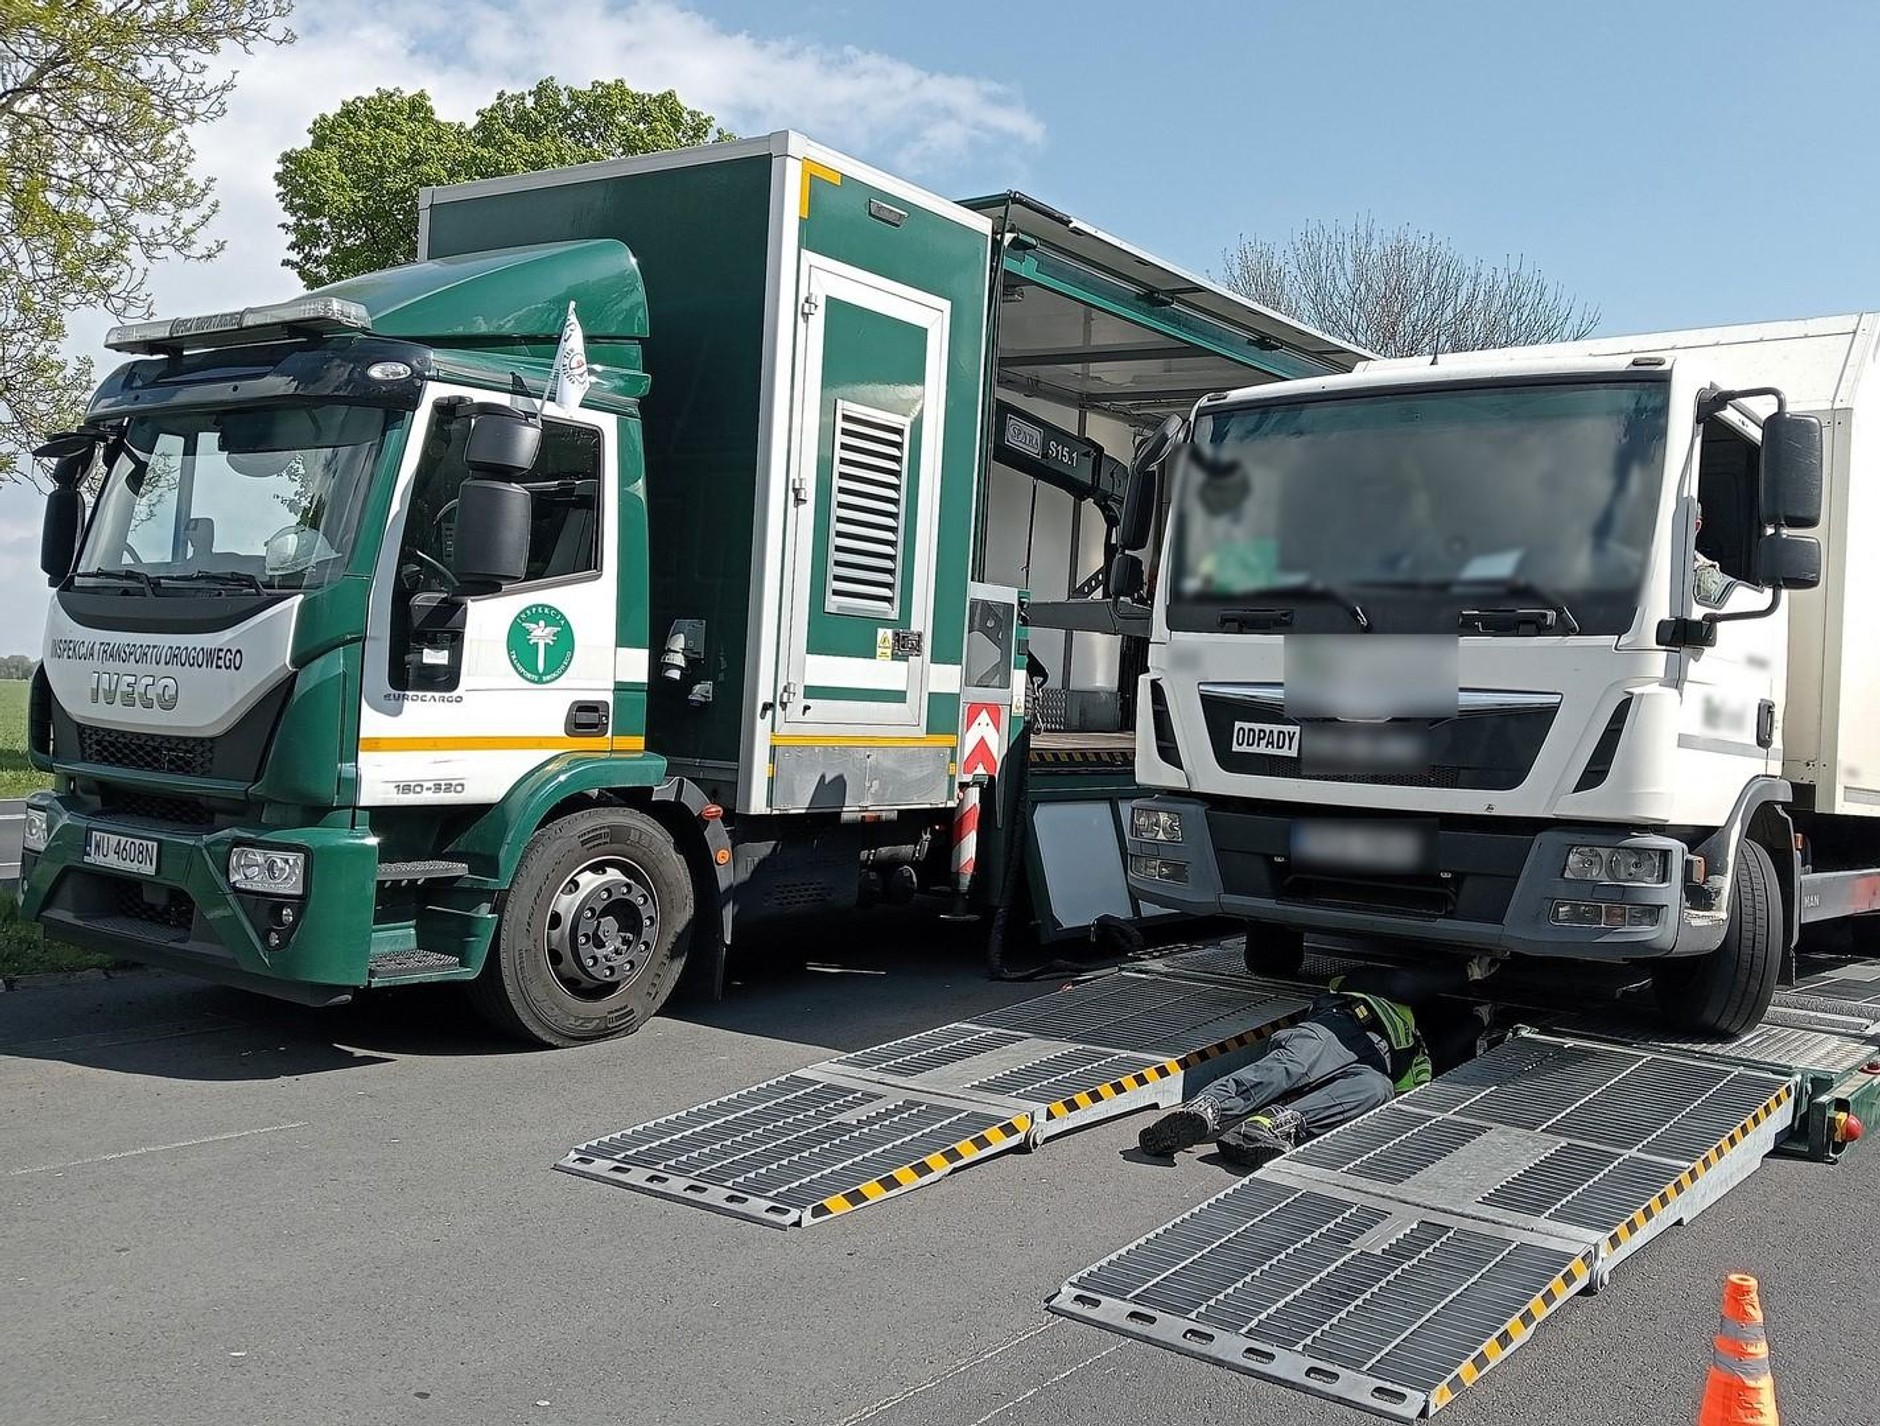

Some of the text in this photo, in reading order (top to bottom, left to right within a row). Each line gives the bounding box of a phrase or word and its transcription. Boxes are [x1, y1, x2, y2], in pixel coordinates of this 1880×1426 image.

[1048, 440, 1078, 468] S15.1
[51, 638, 243, 671] INSPEKCJA TRANSPORTU DROGOWEGO
[91, 671, 180, 712] IVECO
[383, 693, 463, 703] EUROCARGO
[1236, 726, 1297, 751] ODPADY
[113, 838, 155, 867] 4608N
